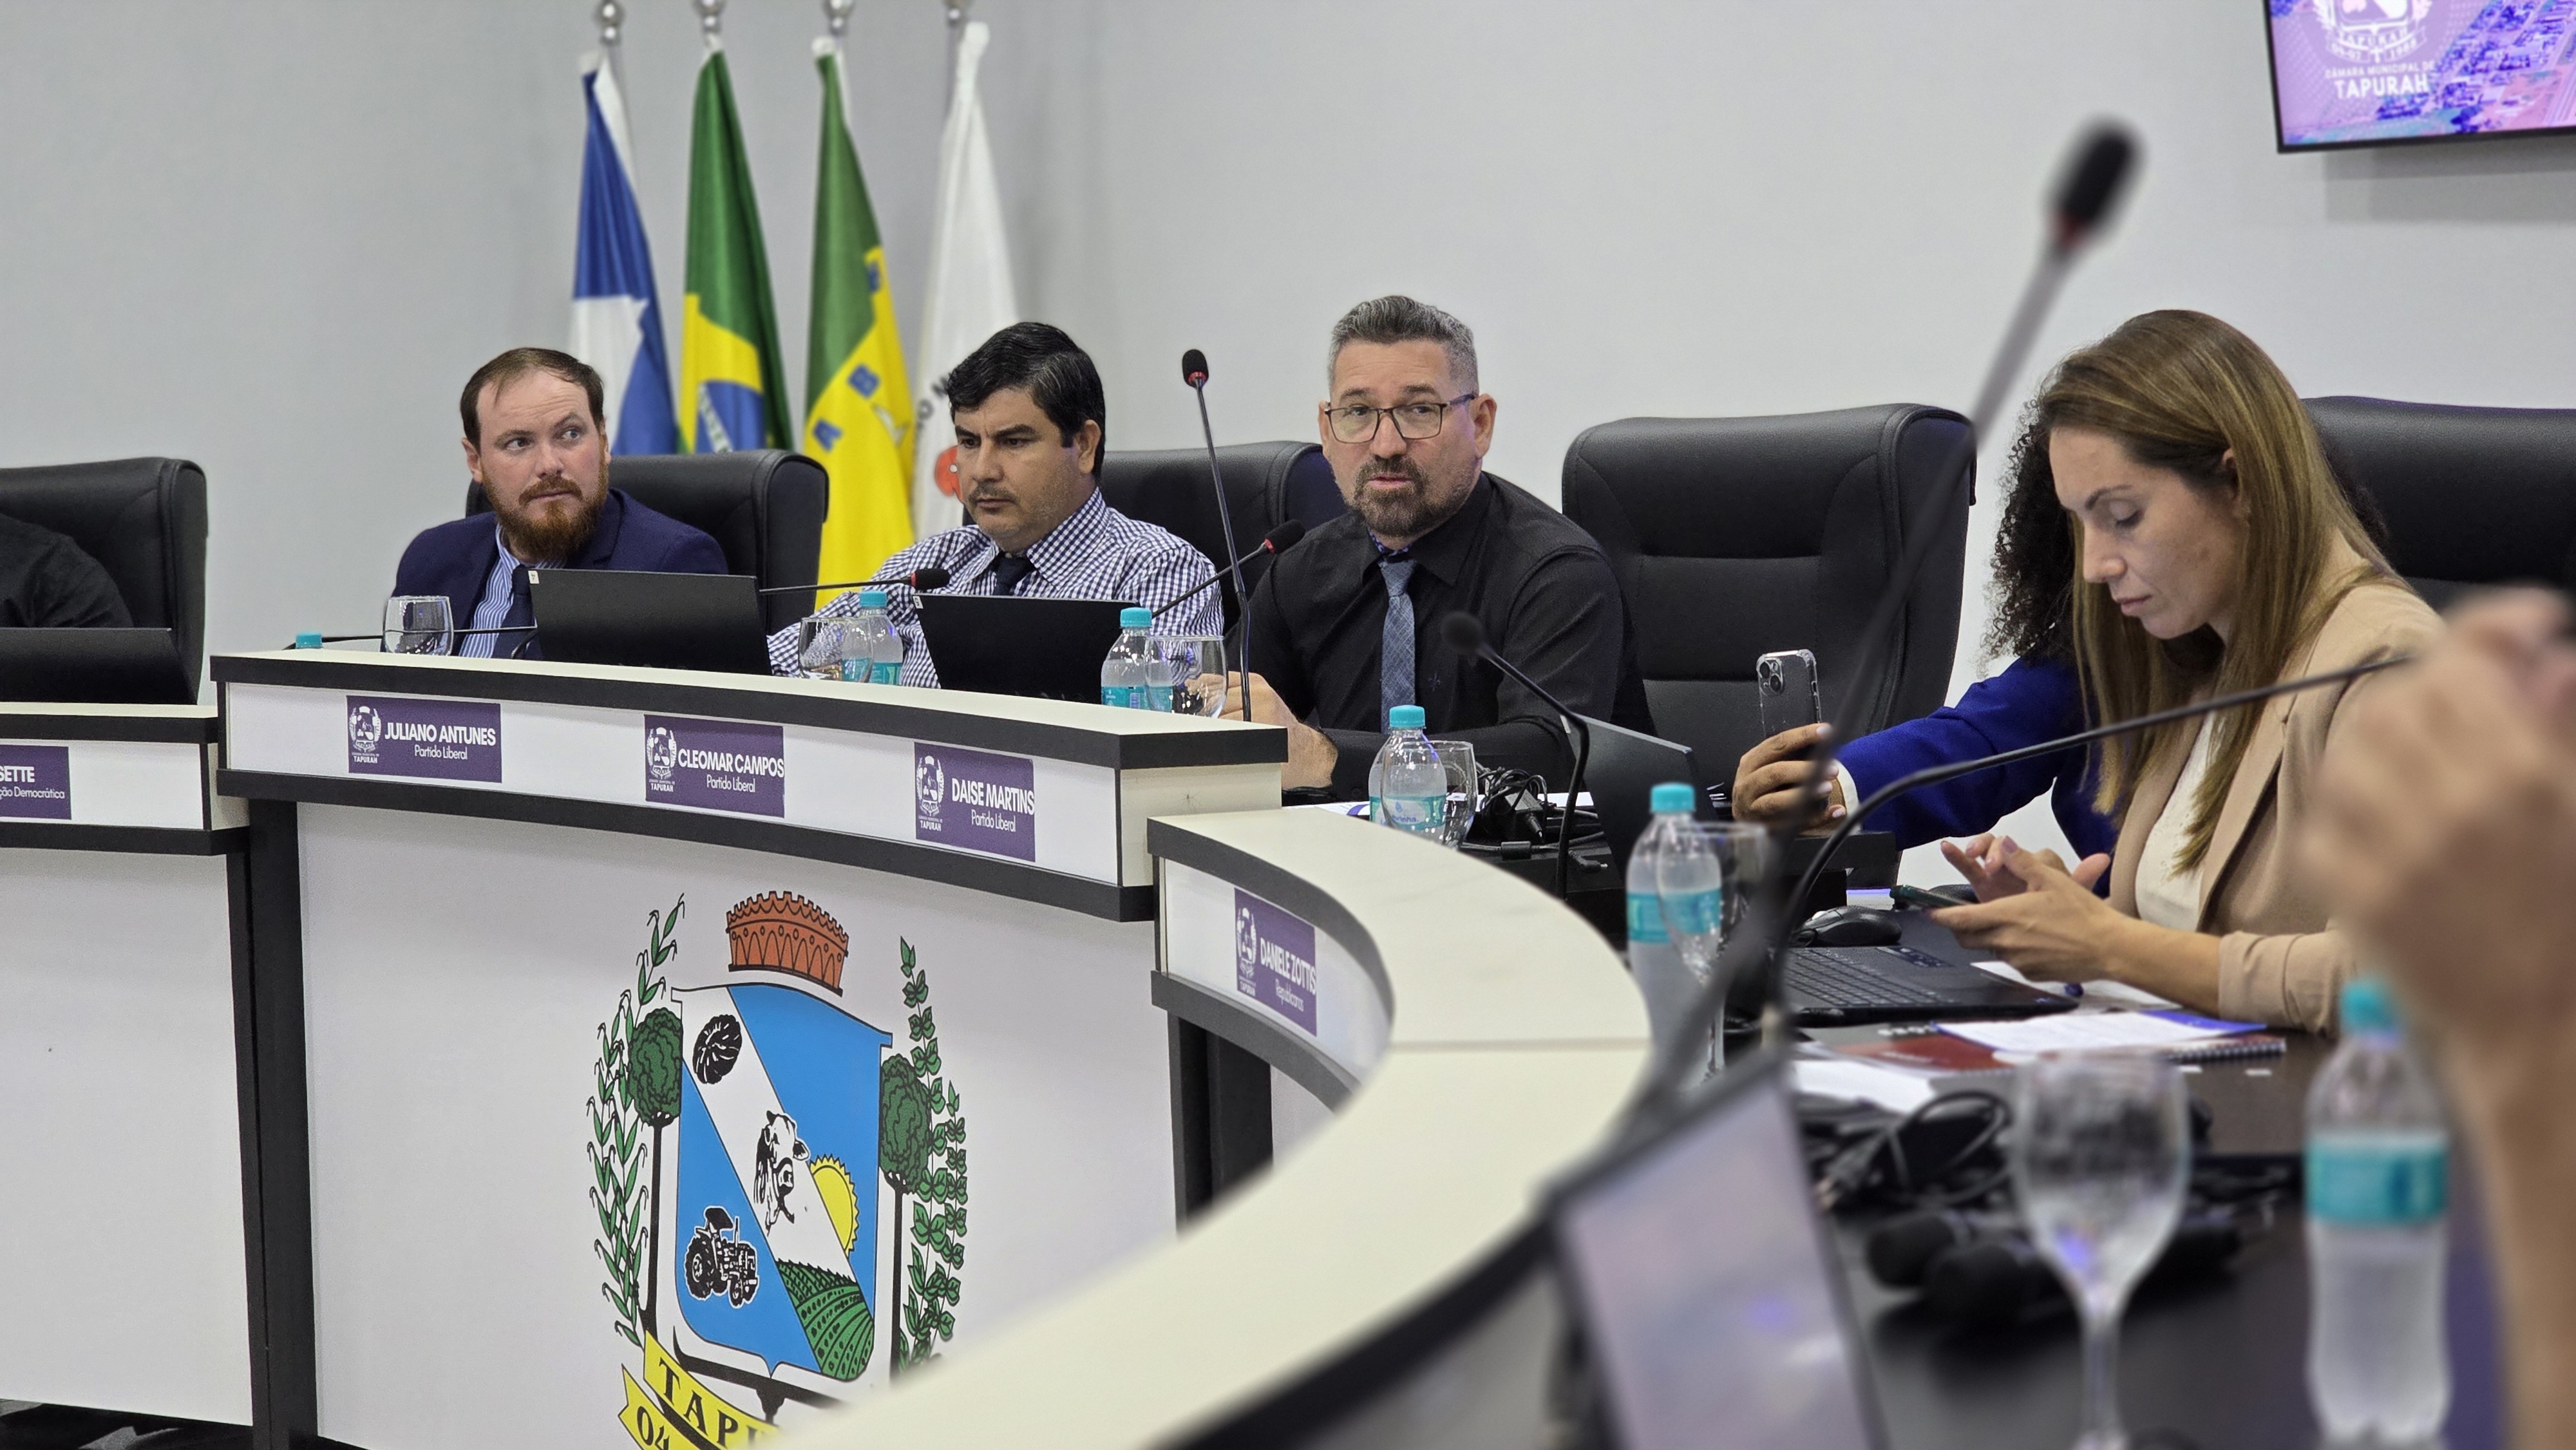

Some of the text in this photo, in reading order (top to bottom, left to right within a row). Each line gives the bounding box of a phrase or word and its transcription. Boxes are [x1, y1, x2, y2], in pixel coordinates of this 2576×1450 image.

[2334, 73, 2429, 99] TAPURAH
[384, 722, 496, 746] JULIANO ANTUNES
[414, 744, 468, 760] Partido Liberal
[678, 749, 784, 778] CLEOMAR CAMPOS
[14, 786, 65, 799] Democrática
[706, 774, 755, 793] Partido Liberal
[952, 778, 1035, 815] DAISE MARTINS
[971, 809, 1016, 832] Partido Liberal
[1260, 937, 1316, 995] DANIELE ZOTTIS
